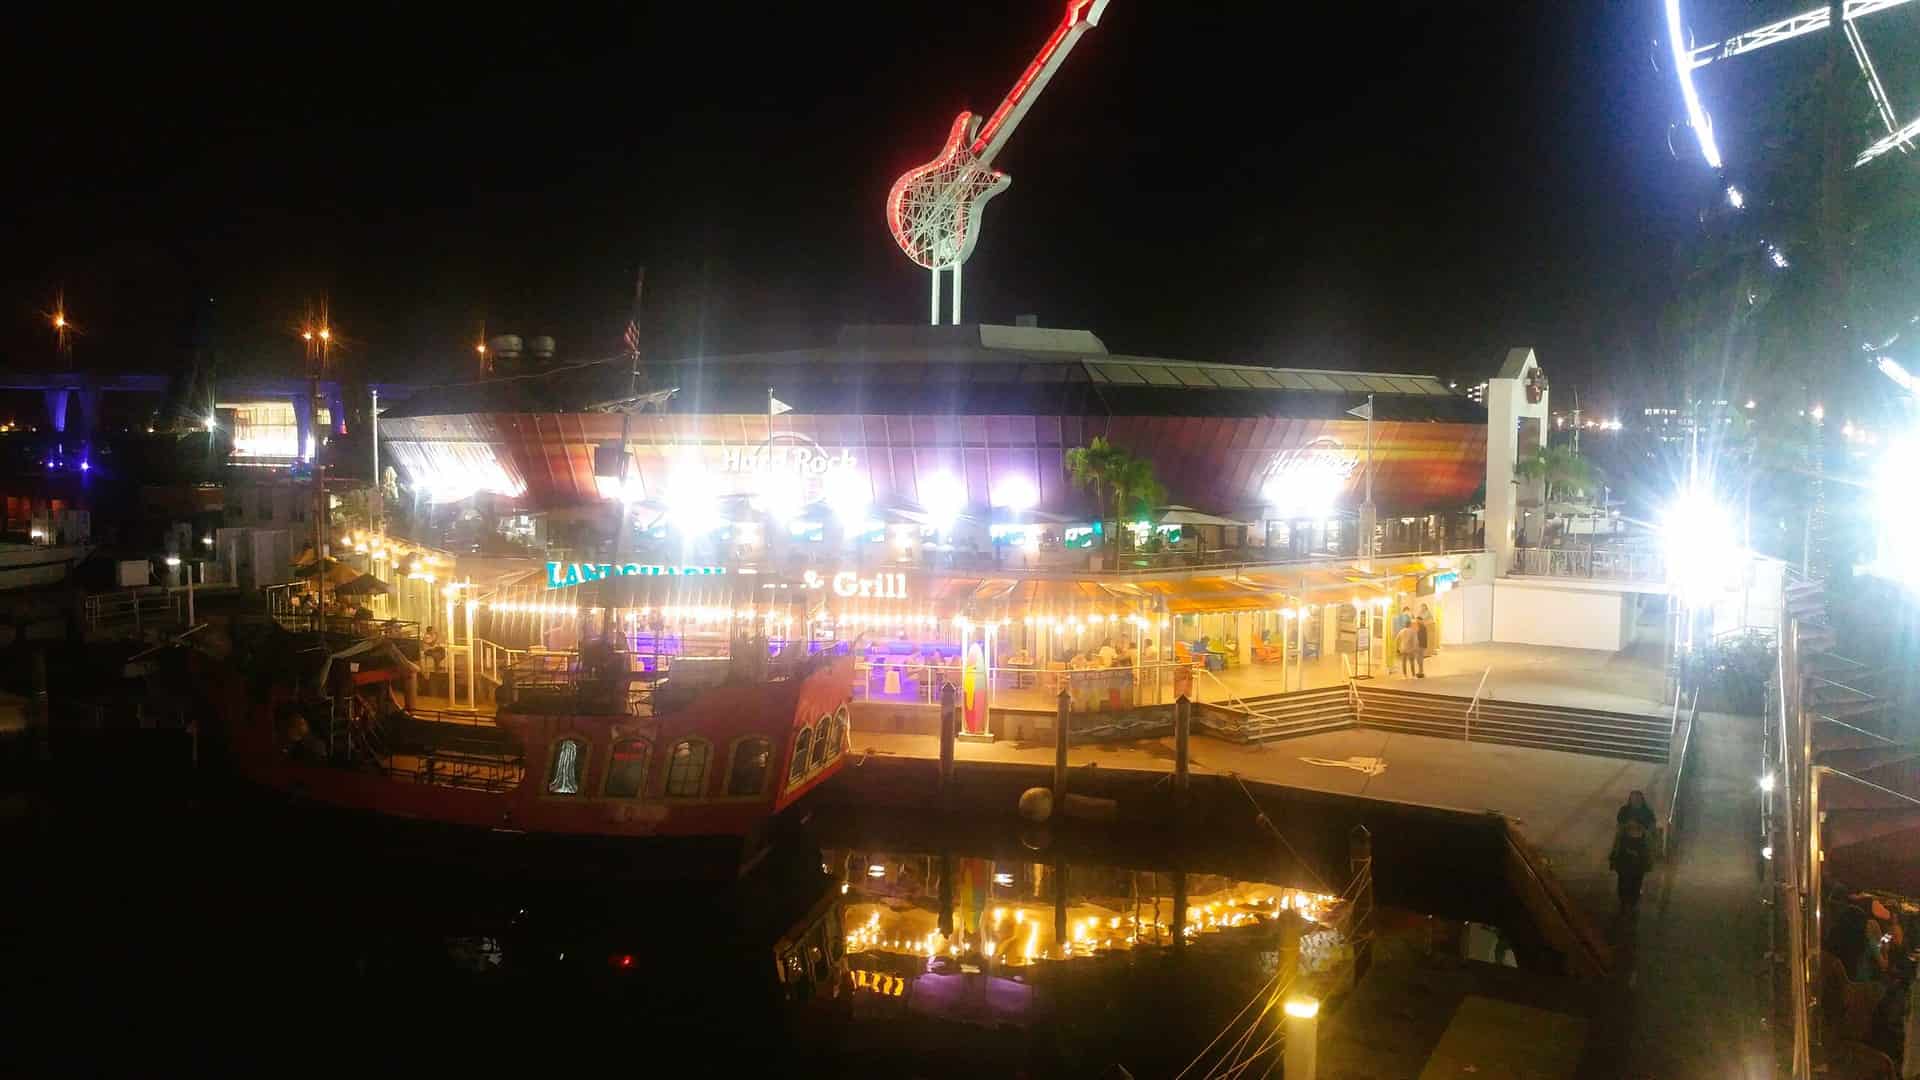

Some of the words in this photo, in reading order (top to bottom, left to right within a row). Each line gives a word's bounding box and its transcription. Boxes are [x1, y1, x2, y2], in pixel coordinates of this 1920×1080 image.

[795, 446, 859, 474] Rock
[802, 569, 824, 589] &
[833, 571, 908, 599] Grill
